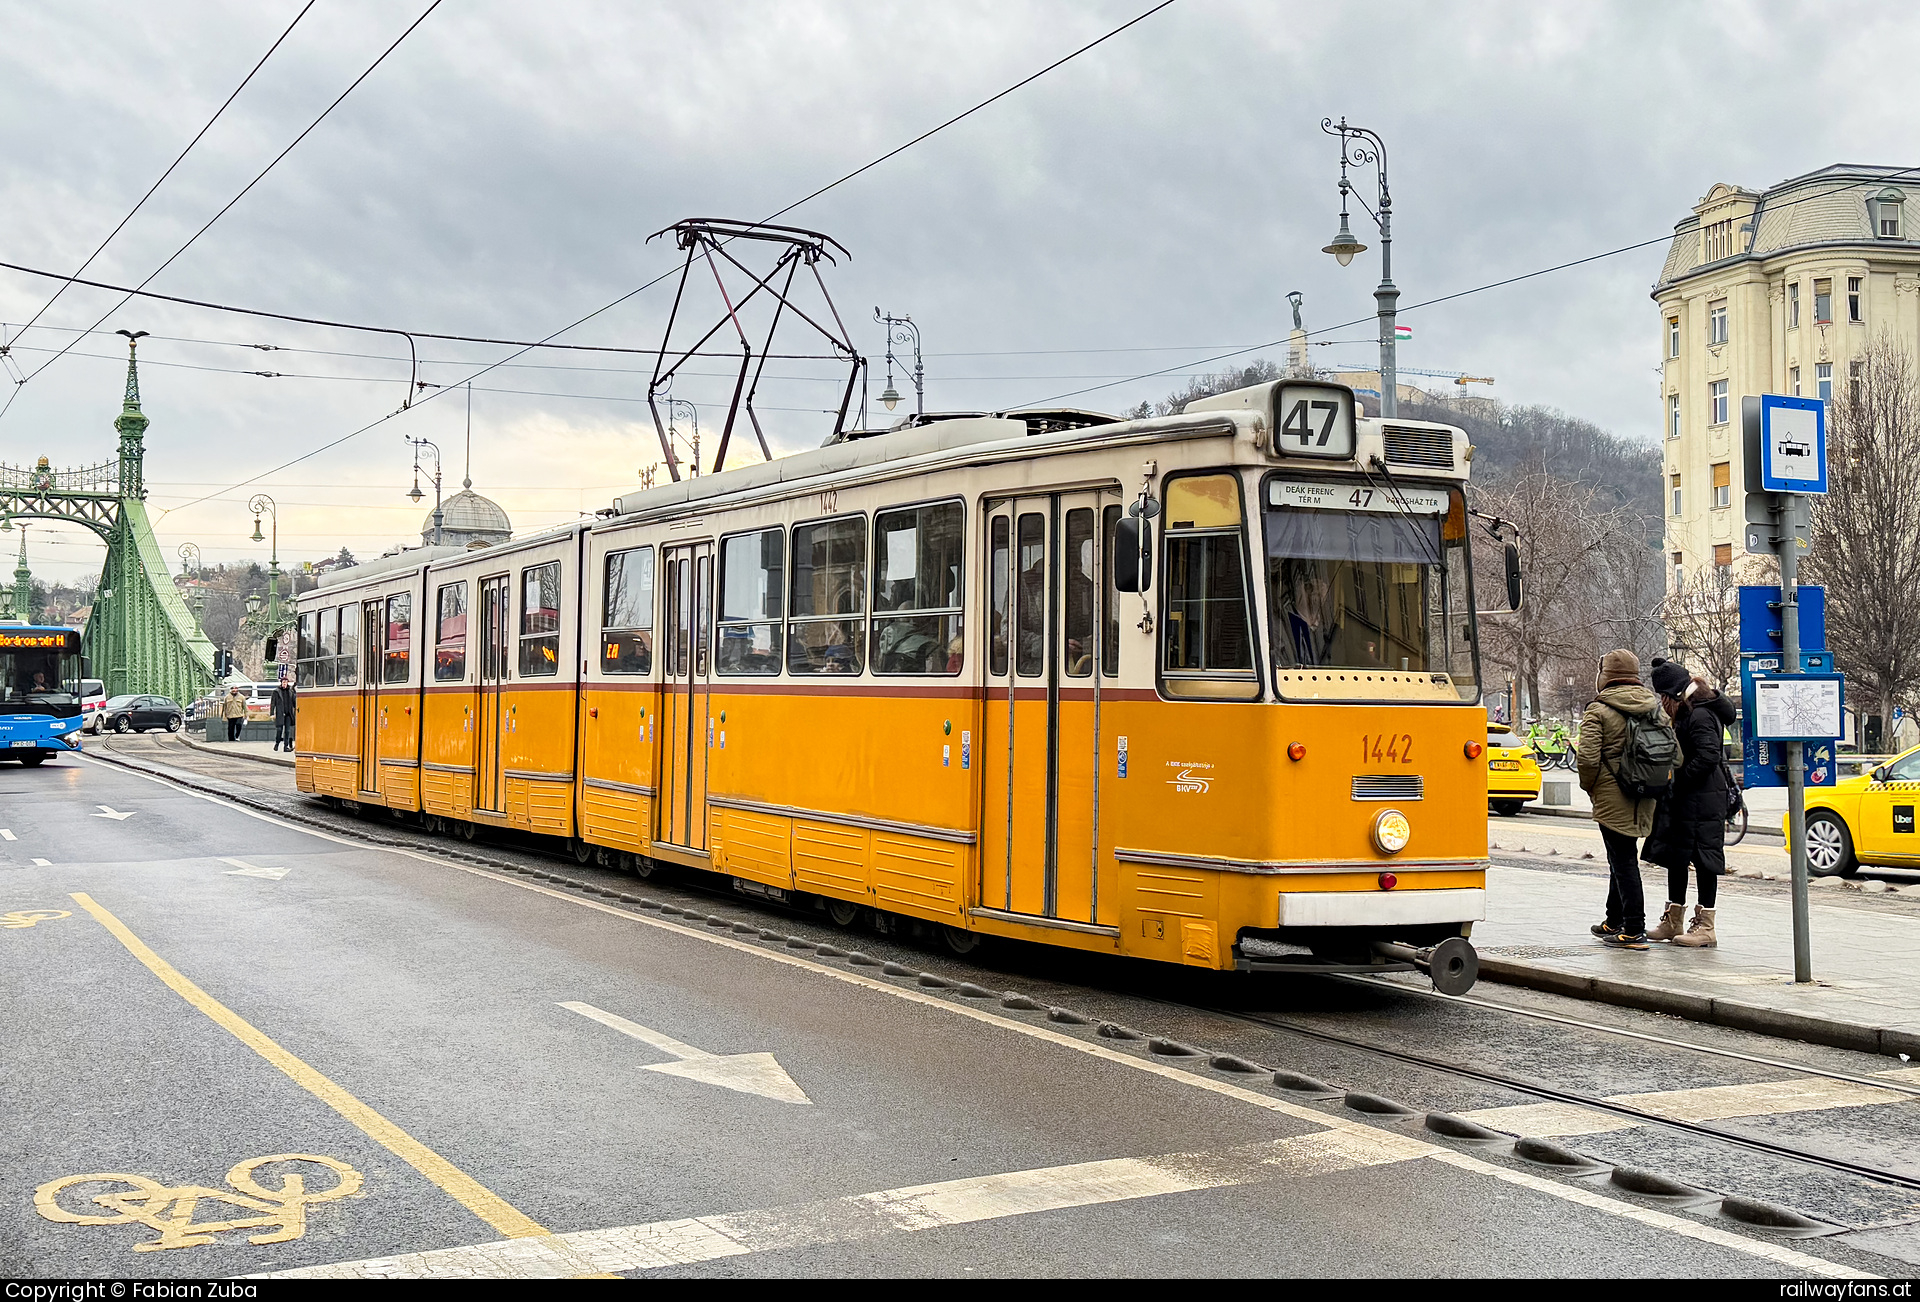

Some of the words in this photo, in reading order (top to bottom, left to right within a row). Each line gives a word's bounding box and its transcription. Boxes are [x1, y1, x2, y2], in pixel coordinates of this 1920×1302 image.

[1282, 400, 1338, 446] 47
[1285, 485, 1306, 494] DEÁK
[1307, 487, 1335, 496] FERENC
[820, 490, 838, 515] 1442
[1298, 495, 1312, 503] TÉR
[1349, 489, 1374, 507] 47
[1425, 498, 1439, 507] TÉR
[56, 634, 65, 646] H
[1362, 734, 1413, 763] 1442
[1894, 814, 1912, 824] Uber
